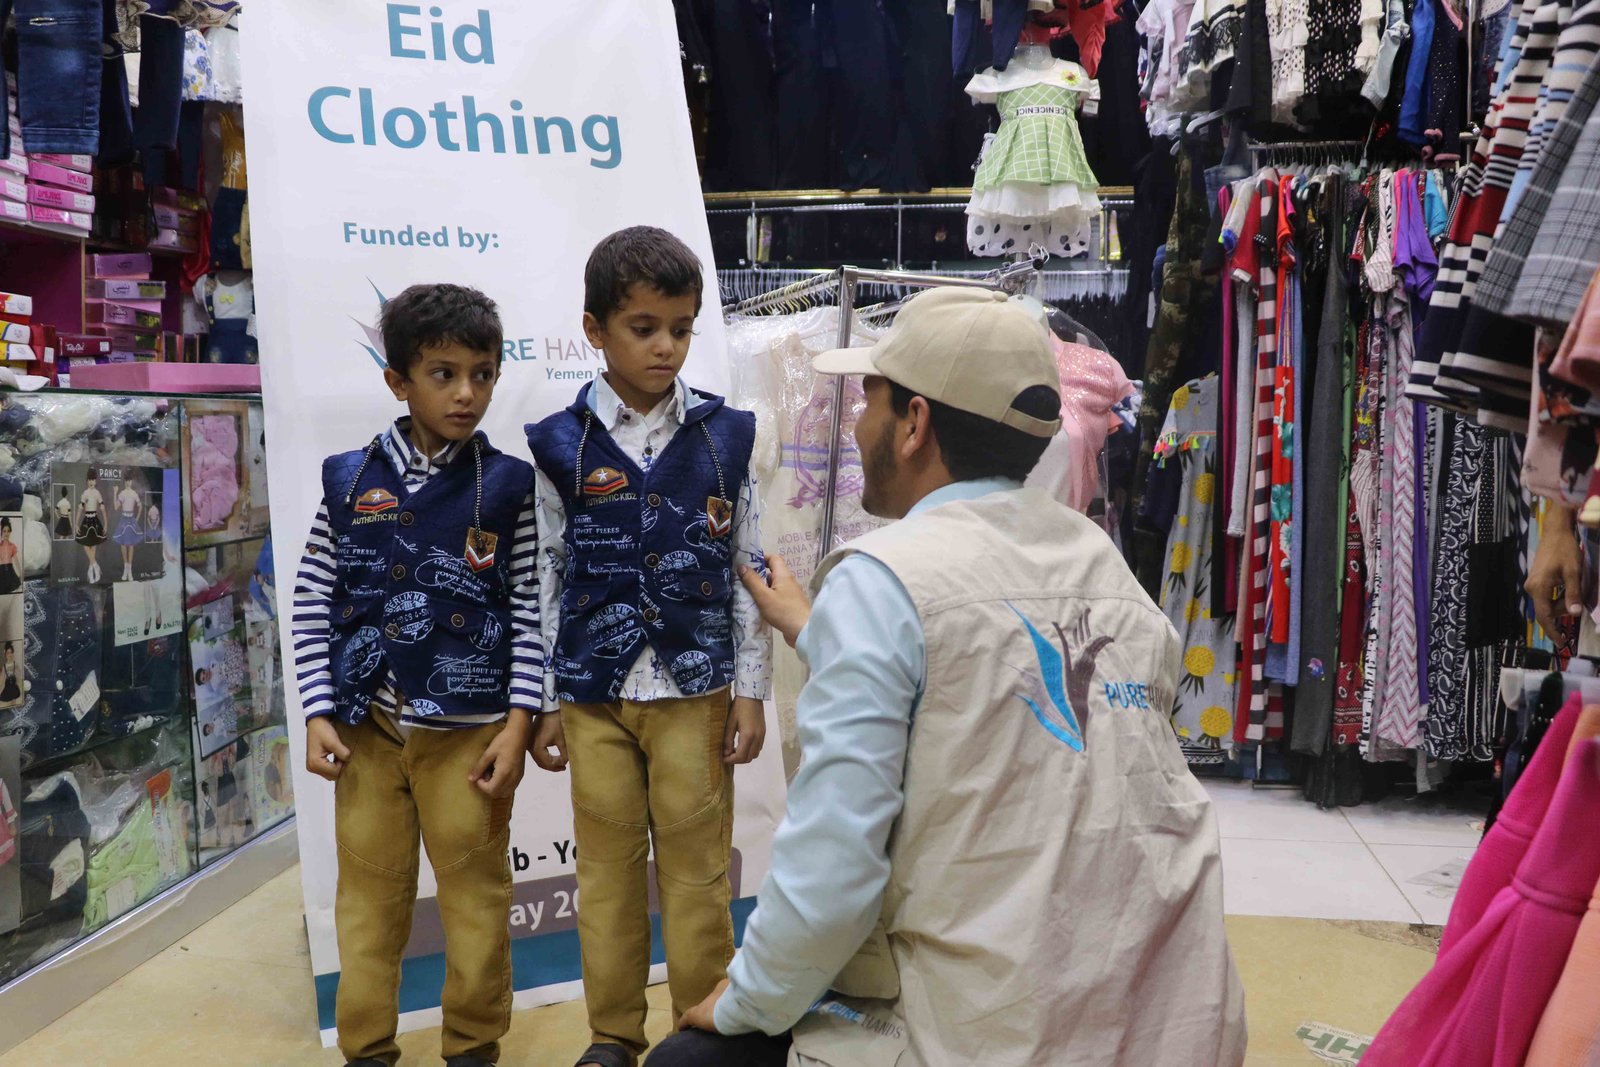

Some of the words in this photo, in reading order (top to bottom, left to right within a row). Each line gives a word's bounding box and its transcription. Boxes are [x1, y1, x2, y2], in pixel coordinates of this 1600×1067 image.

[387, 4, 494, 64] Eid
[308, 86, 621, 169] Clothing
[343, 222, 449, 247] Funded
[457, 228, 499, 253] by:
[501, 338, 536, 361] RE
[545, 338, 607, 361] HAN
[546, 368, 593, 380] Yemen
[352, 513, 387, 525] AUTHENTIC
[385, 593, 412, 614] BERLIN
[588, 606, 614, 631] BERLIN
[1105, 681, 1149, 709] PURE
[509, 901, 545, 931] ay
[860, 1013, 903, 1040] HANDS
